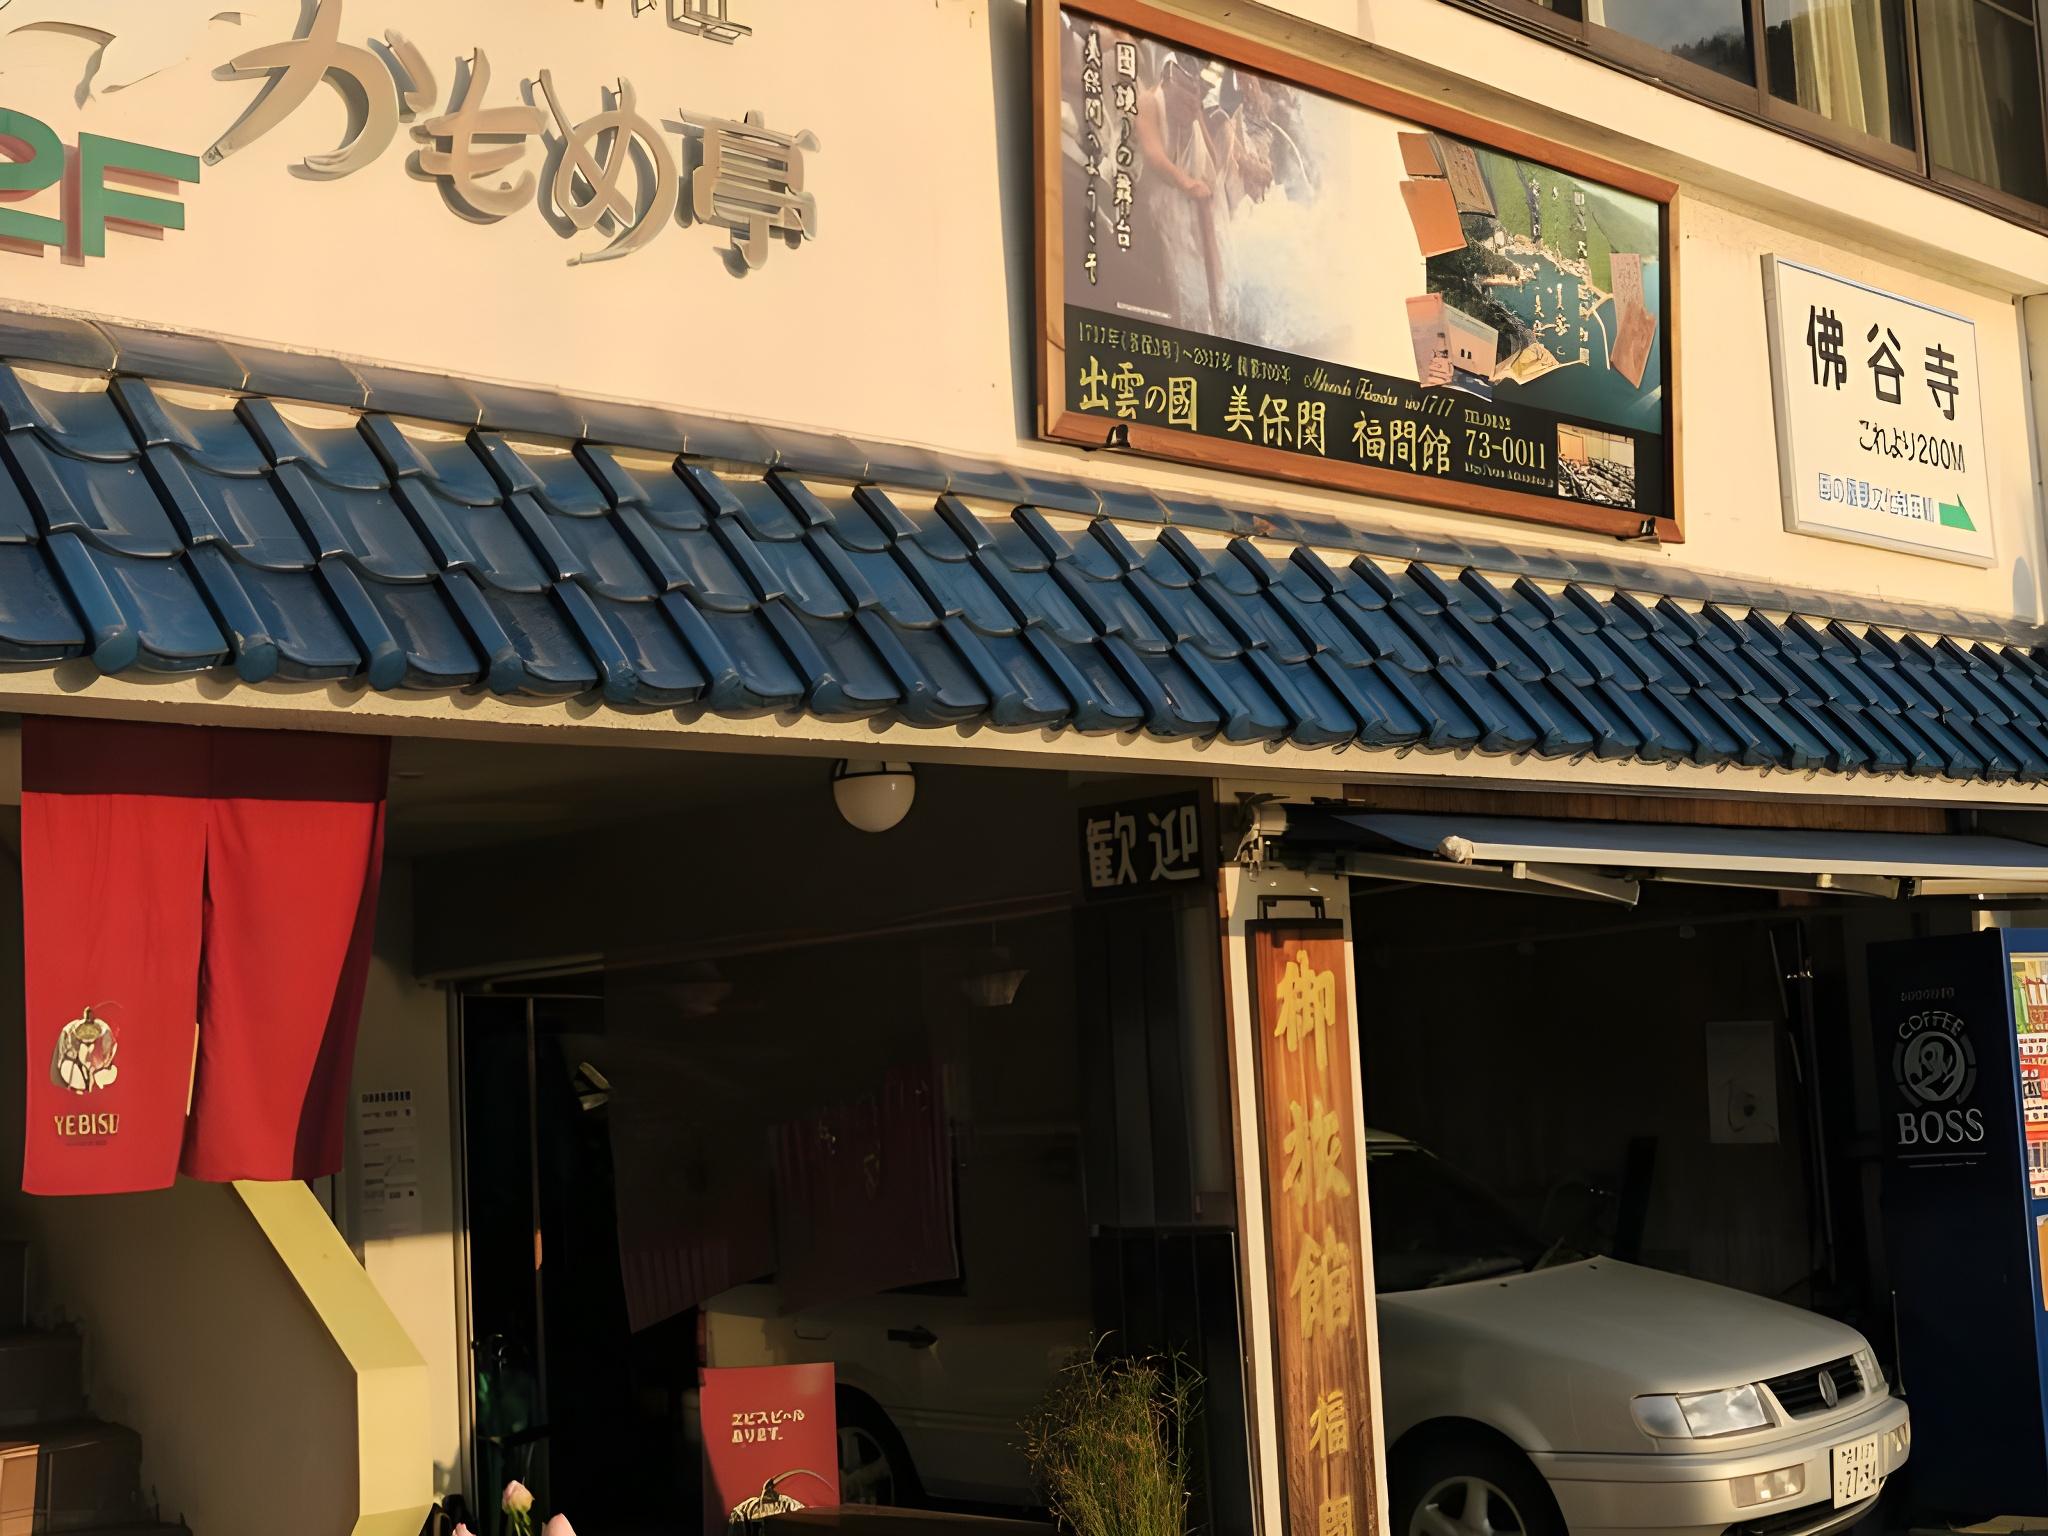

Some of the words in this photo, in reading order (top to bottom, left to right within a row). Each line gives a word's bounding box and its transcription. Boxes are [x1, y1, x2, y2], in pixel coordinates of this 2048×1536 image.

[0, 107, 200, 266] 2F
[1806, 304, 1960, 421] 佛谷寺
[1079, 355, 1199, 432] 出雲の國
[1223, 383, 1327, 457] 美保関
[1351, 410, 1452, 475] 福間館
[1465, 429, 1546, 470] 73-0011
[1898, 1010, 1966, 1040] COFFEE
[54, 1113, 120, 1136] YEBISU
[1897, 1108, 1985, 1146] BOSS
